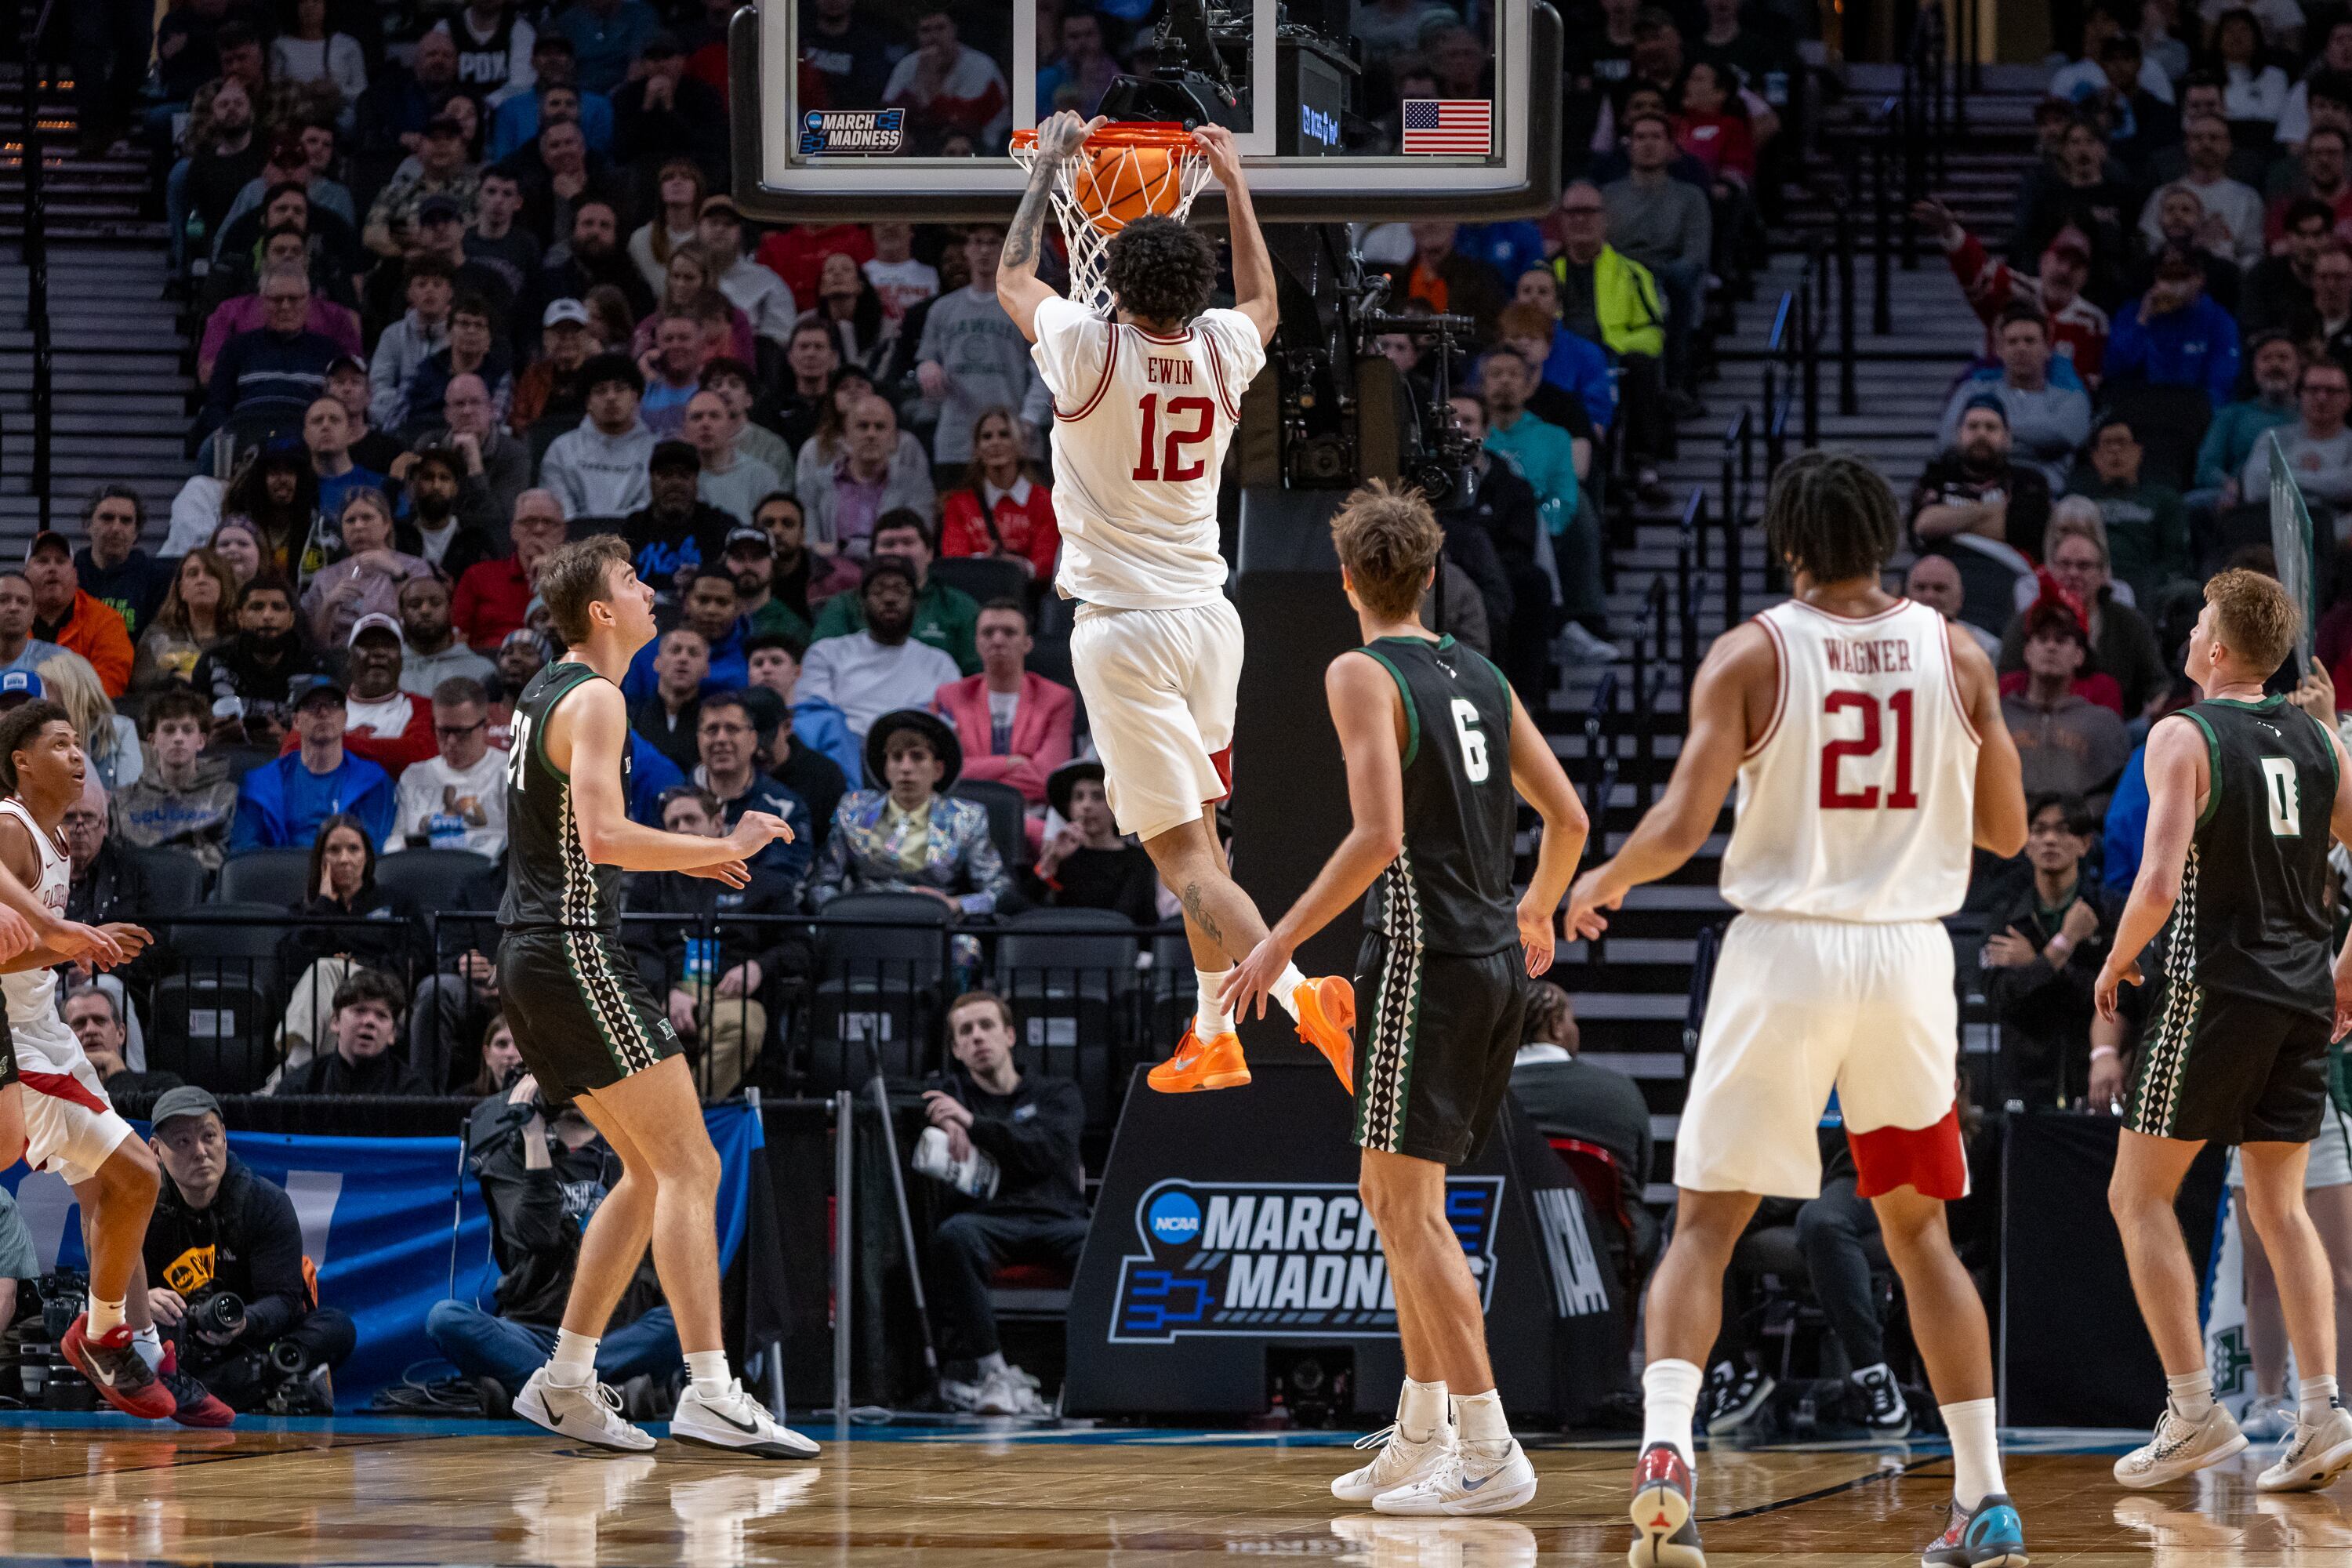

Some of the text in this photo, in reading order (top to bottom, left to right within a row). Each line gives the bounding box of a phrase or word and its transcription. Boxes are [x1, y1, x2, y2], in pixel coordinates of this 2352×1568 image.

[822, 114, 876, 130] MARCH
[828, 130, 900, 146] MADNESS
[1148, 357, 1193, 385] EWIN
[1132, 393, 1215, 481] 12
[1824, 638, 1913, 673] WAGNER
[1450, 696, 1490, 785] 6
[1819, 688, 1919, 810] 21
[2259, 755, 2300, 838] 0
[1155, 1217, 1199, 1231] NCAA
